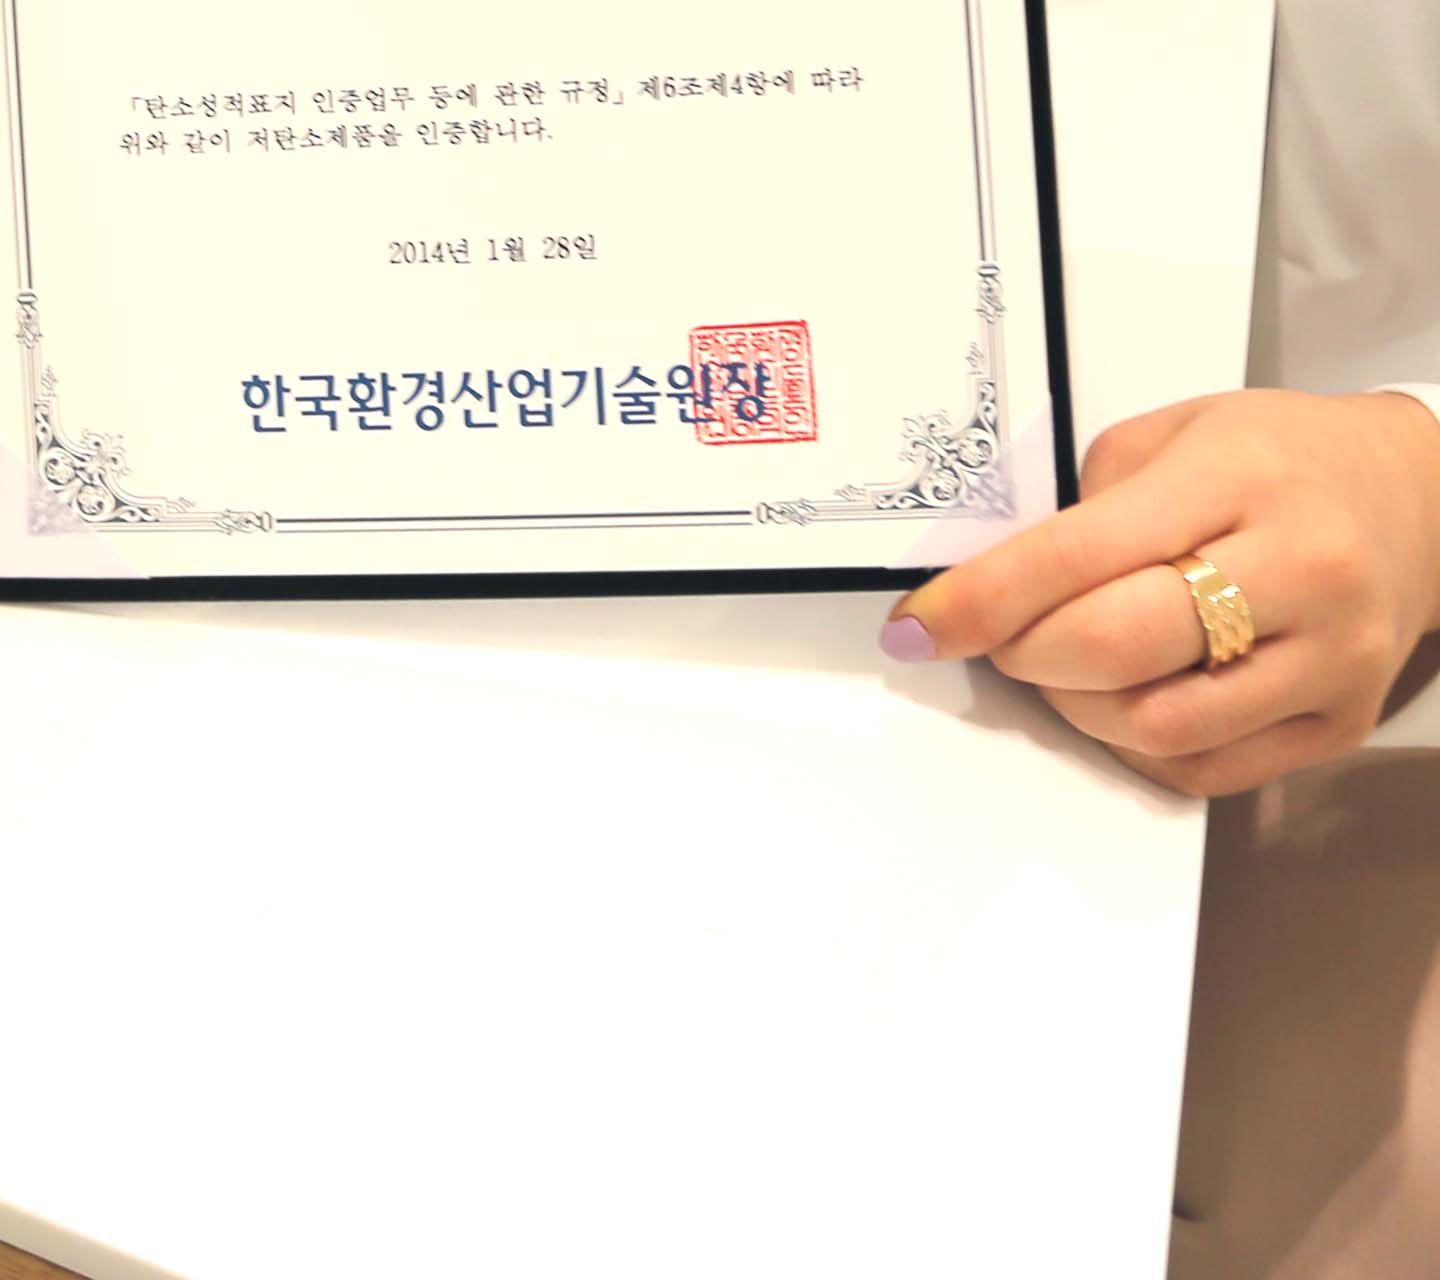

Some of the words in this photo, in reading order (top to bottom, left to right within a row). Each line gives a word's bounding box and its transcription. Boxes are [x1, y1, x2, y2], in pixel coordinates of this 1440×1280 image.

[312, 87, 415, 113] 인증업무
[495, 81, 545, 106] 관한
[810, 67, 863, 92] 따라
[120, 131, 168, 155] 위와
[184, 129, 230, 154] 같이
[249, 123, 402, 151] 저탄소제품을
[416, 117, 552, 145] 인증합니다.
[389, 238, 470, 264] 2014년
[488, 237, 526, 262] 1월
[543, 234, 596, 260] 28일
[241, 366, 772, 433] 한국환경산업기술원장
